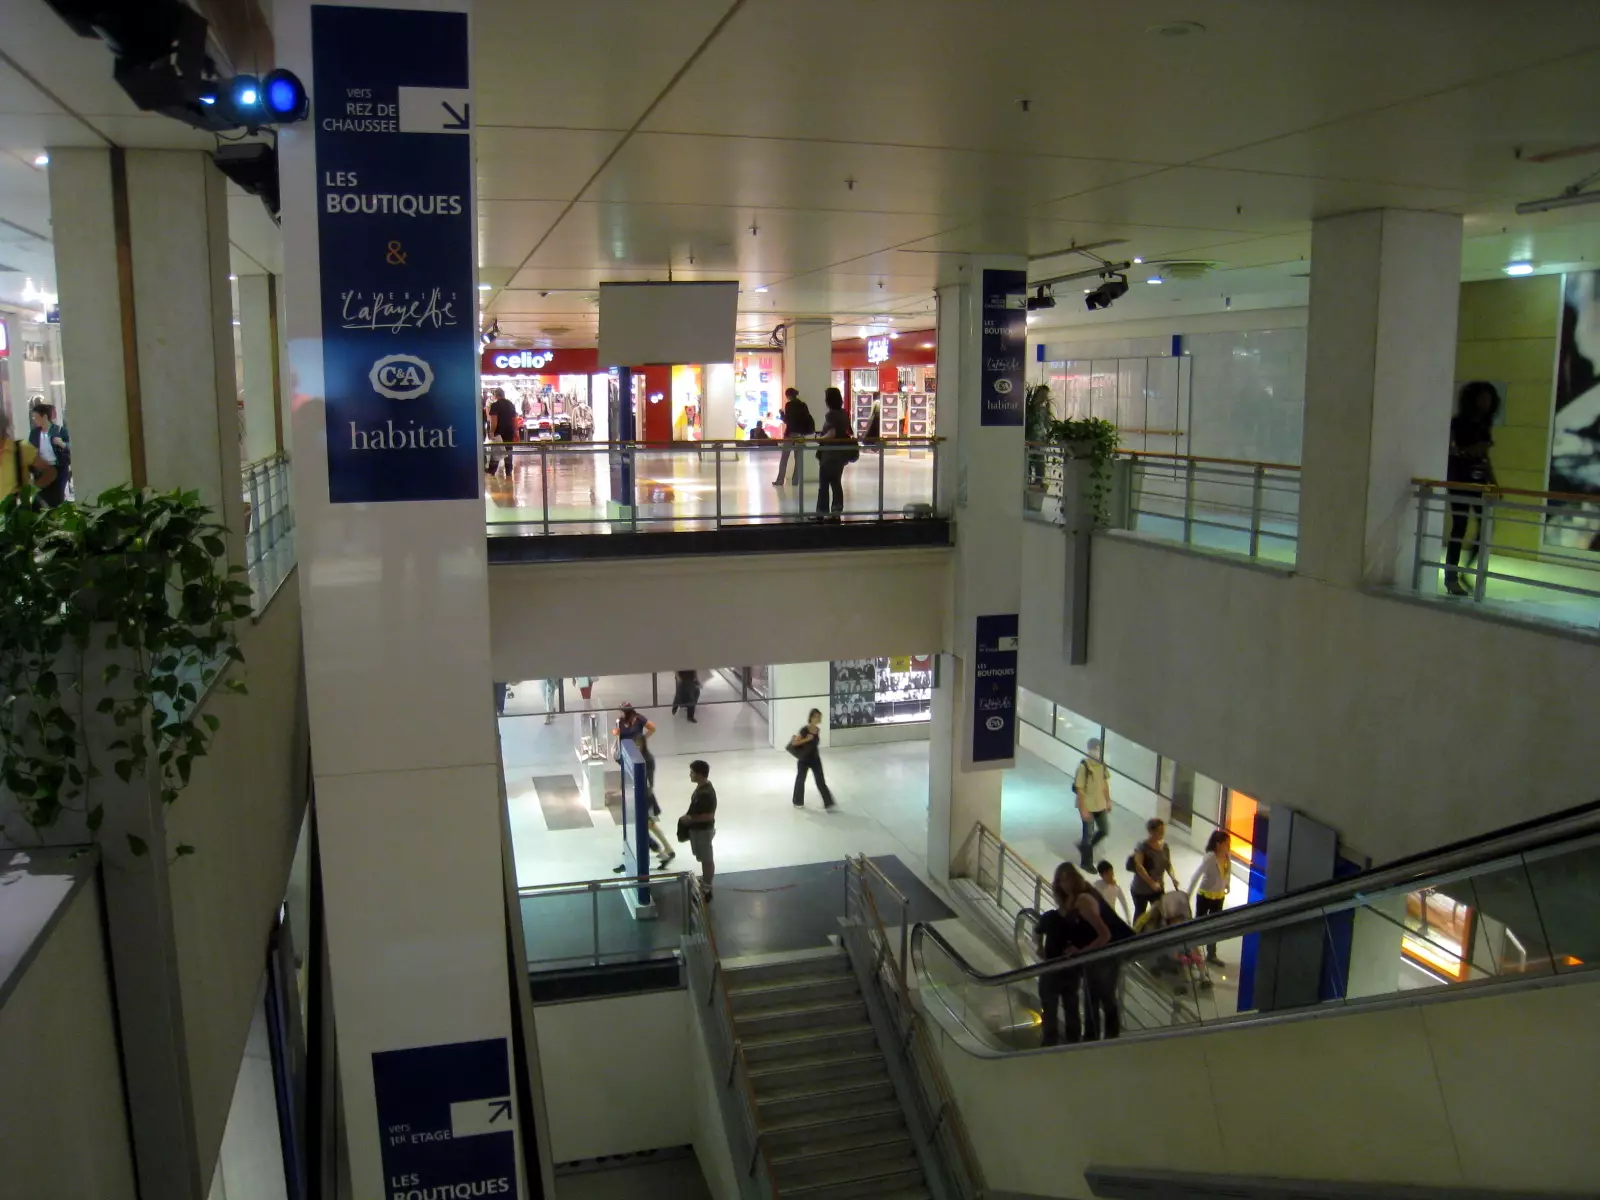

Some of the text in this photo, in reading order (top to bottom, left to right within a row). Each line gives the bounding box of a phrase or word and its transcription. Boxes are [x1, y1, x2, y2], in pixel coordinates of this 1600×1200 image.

[346, 88, 372, 98] vers
[346, 103, 397, 117] REZ DE
[322, 118, 397, 133] CHAUSSEE
[326, 171, 358, 187] LES
[326, 193, 462, 217] BOUTIQUES
[386, 240, 407, 265] &
[349, 420, 458, 450] habitat
[977, 668, 1015, 677] BOUTIQUES
[388, 1123, 411, 1134] vers
[411, 1129, 452, 1144] ETAGE
[392, 1173, 420, 1188] LES
